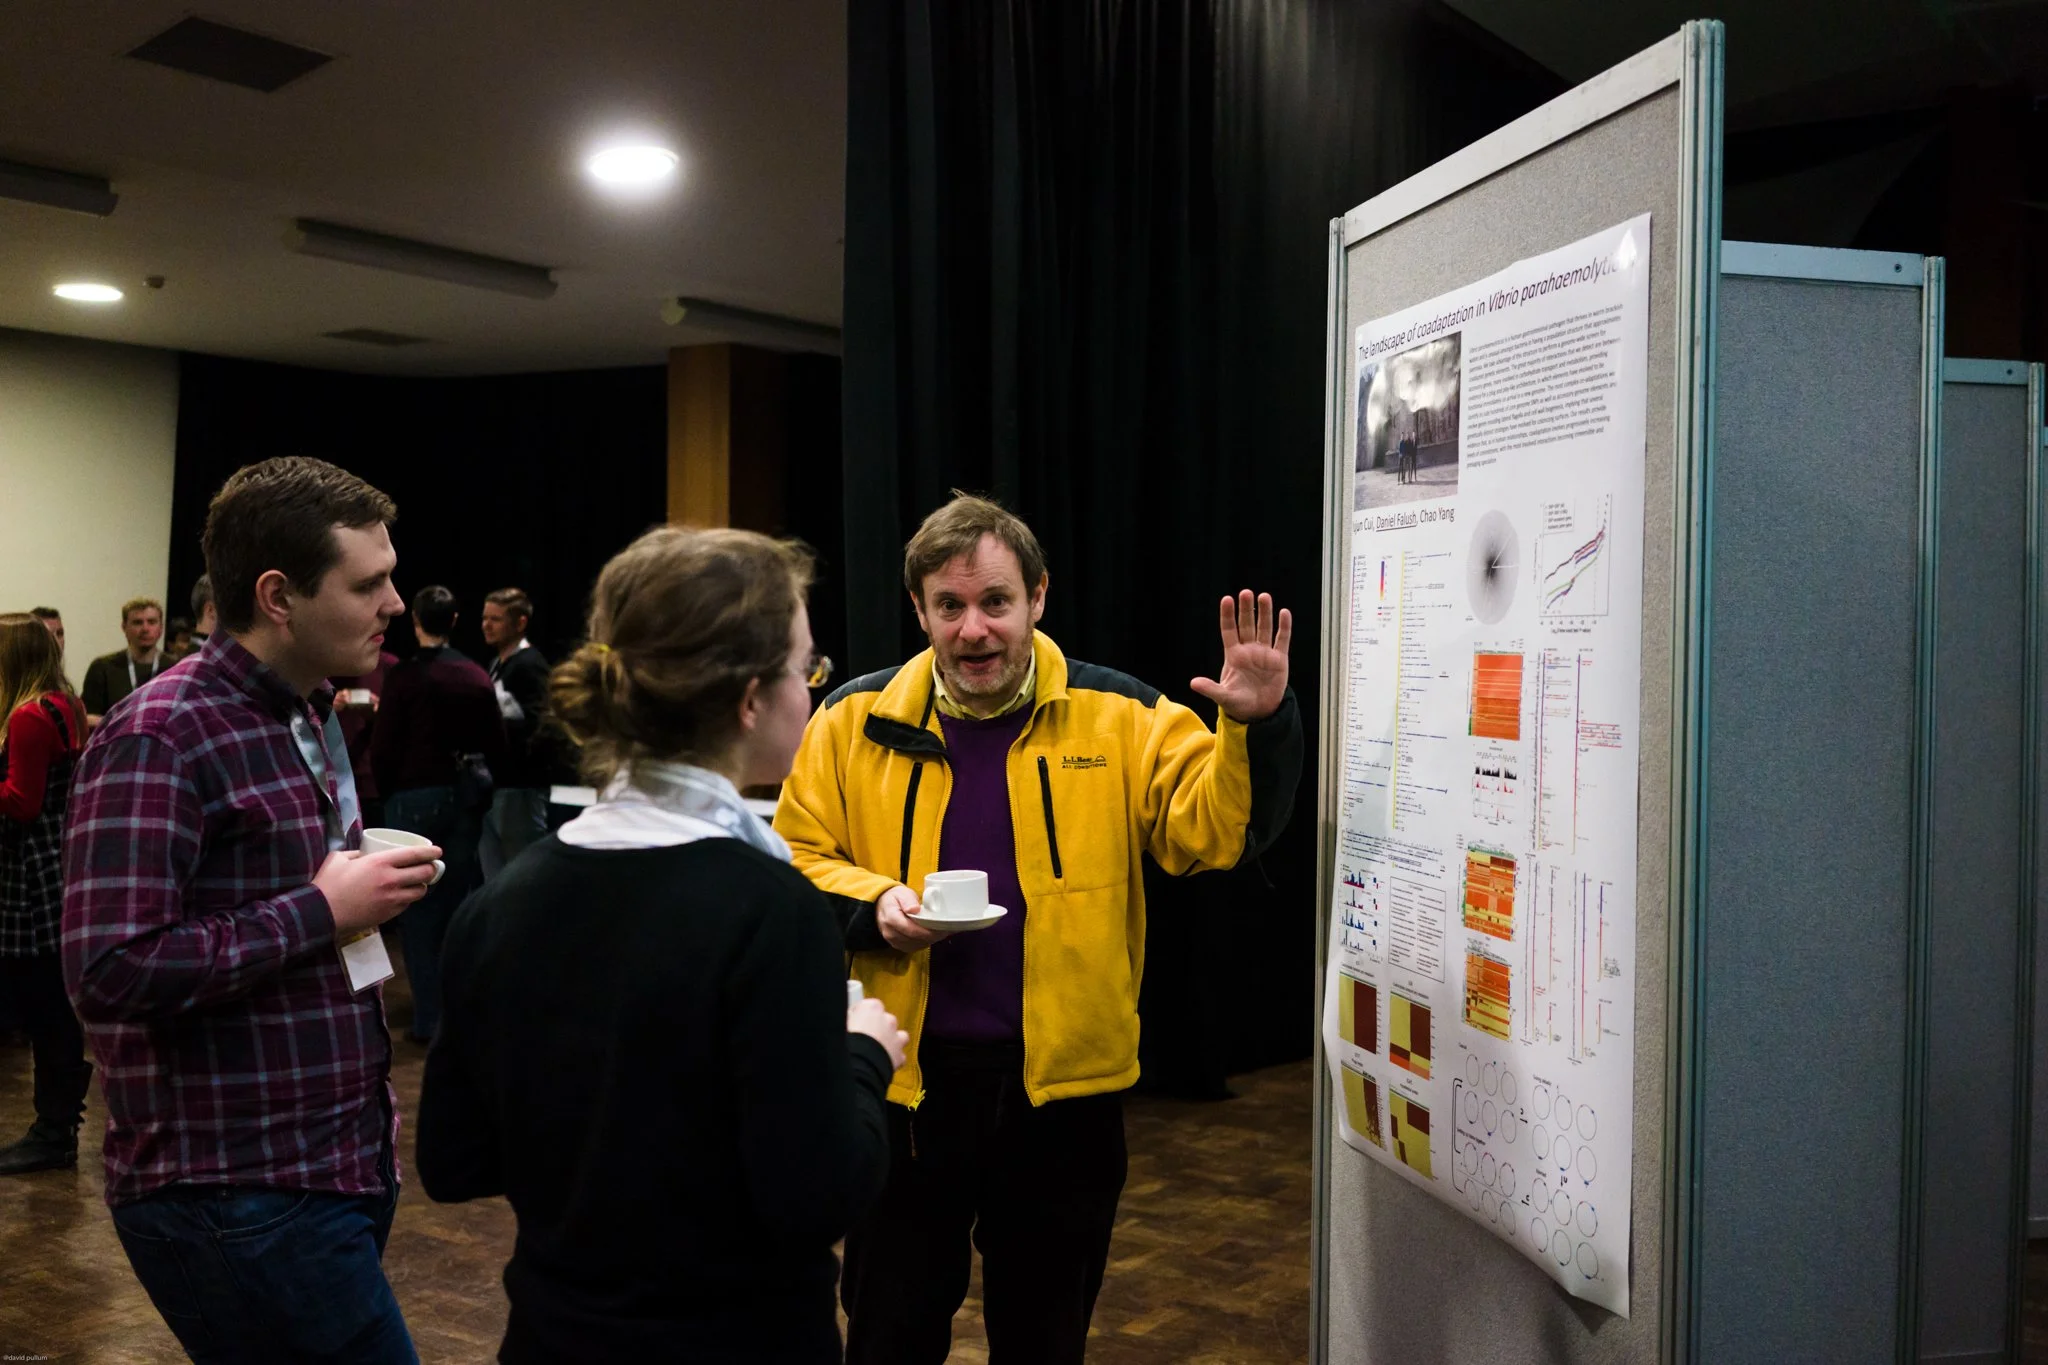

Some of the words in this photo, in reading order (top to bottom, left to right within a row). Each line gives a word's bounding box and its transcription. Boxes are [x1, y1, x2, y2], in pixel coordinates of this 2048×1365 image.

[1359, 346, 1368, 359] The
[1370, 332, 1405, 356] landscape
[1407, 322, 1417, 342] of
[1417, 305, 1474, 338] coadaptation
[1476, 298, 1485, 317] in
[1489, 286, 1519, 312] Vibrio
[1364, 516, 1375, 531] Cui,
[1376, 514, 1396, 529] Daniel
[1397, 511, 1418, 527] Falush,
[1420, 509, 1436, 523] Chao
[1438, 507, 1455, 523] Yang
